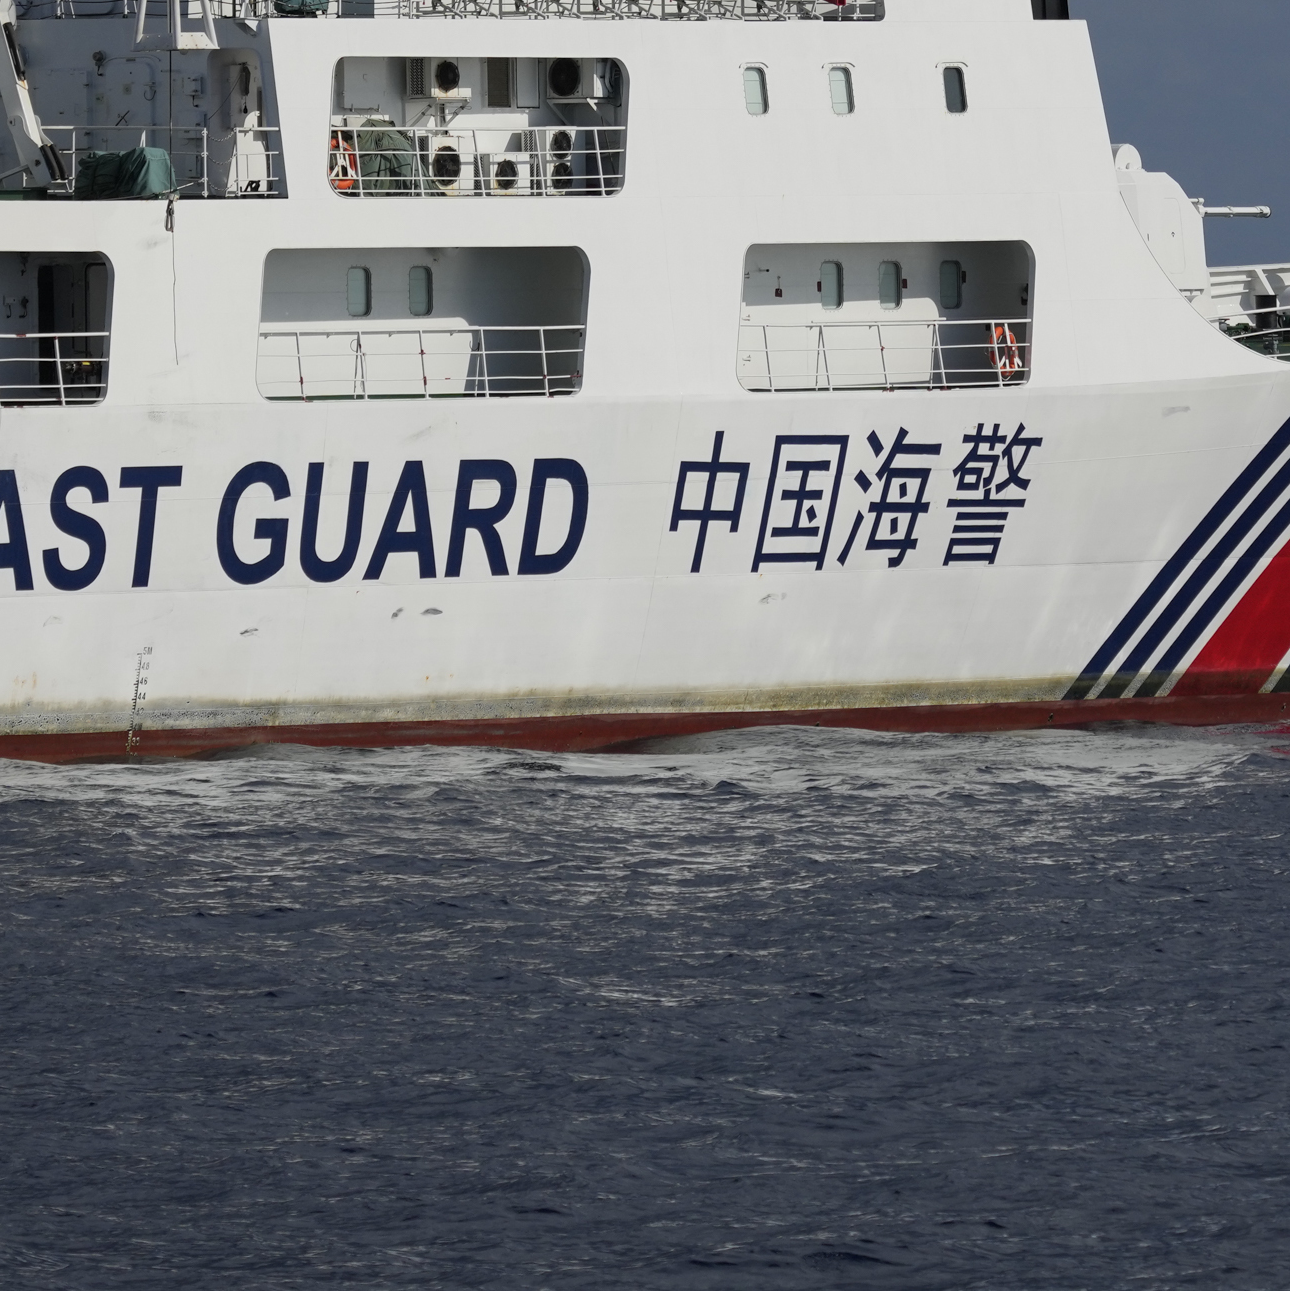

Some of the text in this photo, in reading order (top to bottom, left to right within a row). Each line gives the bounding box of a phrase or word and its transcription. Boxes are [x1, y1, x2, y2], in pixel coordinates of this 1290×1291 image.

[216, 457, 589, 586] GUARD
[669, 422, 1044, 574] 中国海警
[137, 692, 146, 701] 44
[139, 676, 148, 686] 46
